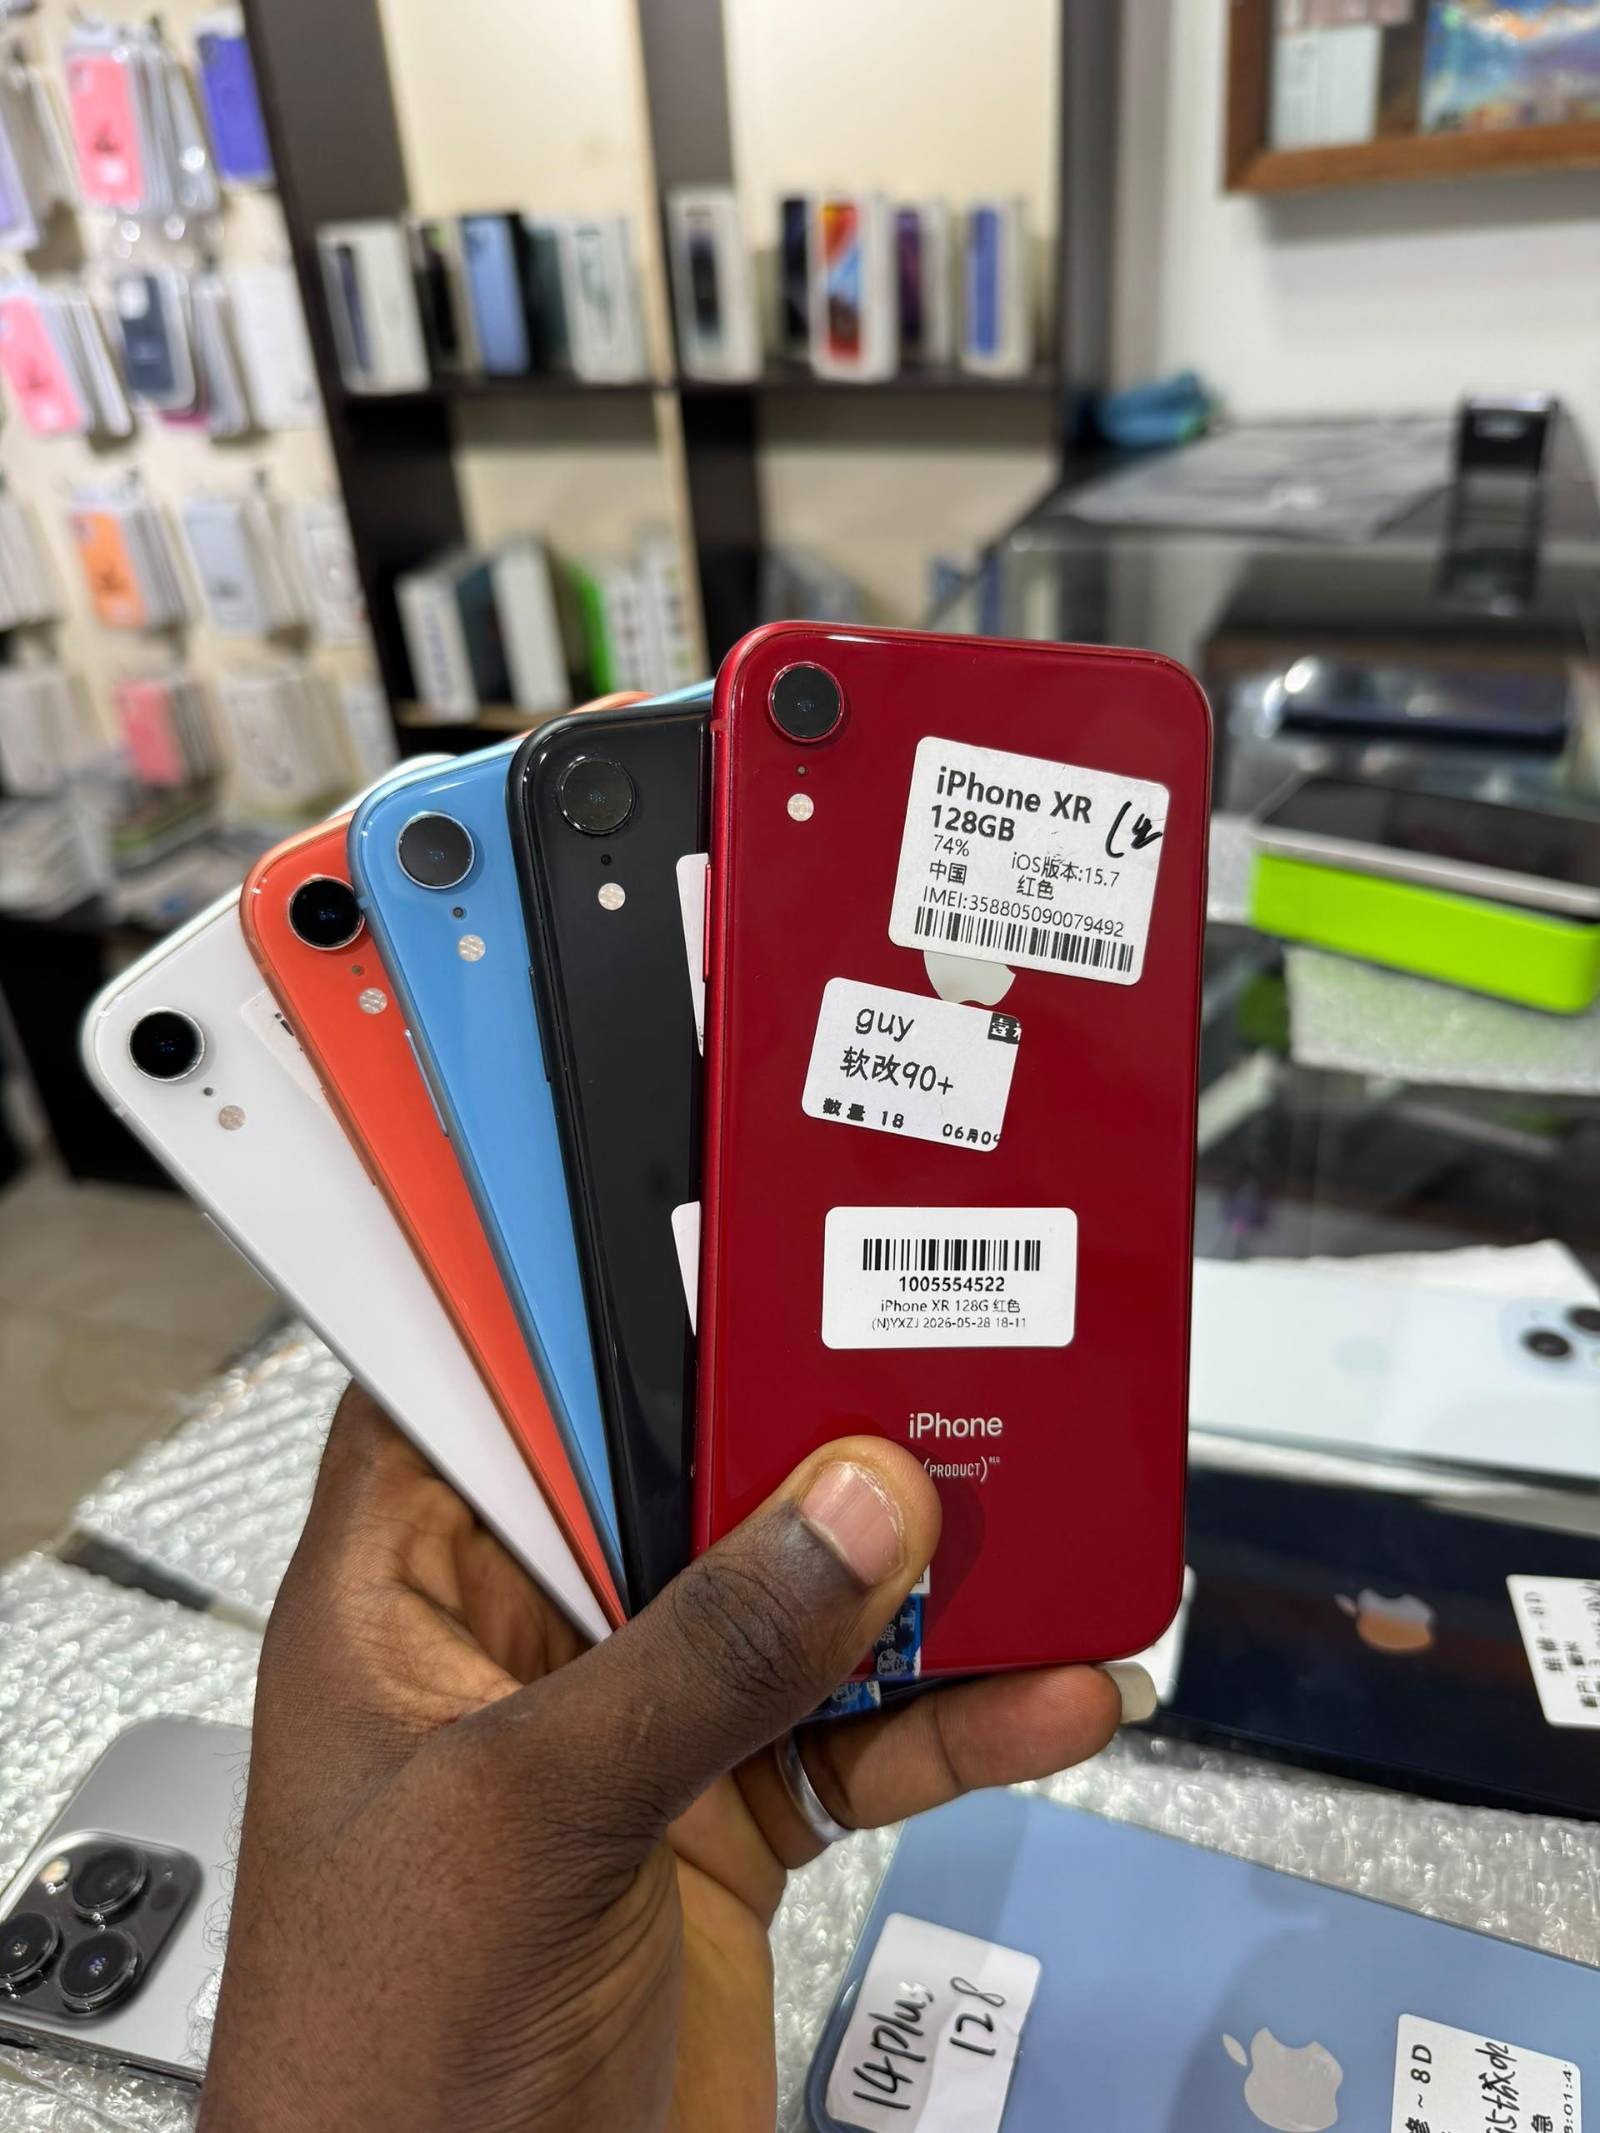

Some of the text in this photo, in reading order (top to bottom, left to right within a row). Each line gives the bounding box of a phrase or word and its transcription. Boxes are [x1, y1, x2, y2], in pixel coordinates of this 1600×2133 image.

[936, 766, 1092, 824] iPhone XR
[931, 804, 1016, 842] 128GB
[933, 834, 970, 858] 74%
[929, 860, 1055, 901] 中国 红色
[923, 886, 1124, 938] IMEI:358805090079492
[855, 1007, 915, 1042] guy
[840, 1046, 954, 1095] 软改90+
[880, 1110, 905, 1129] 18
[898, 1276, 1006, 1292] 1005554522
[881, 1298, 1021, 1314] iPhone XR 128G 红色
[923, 1317, 991, 1329] 2026-05-28
[996, 1317, 1027, 1329] 18-11
[908, 1411, 1004, 1439] iPhone
[949, 1976, 1006, 2057] 128
